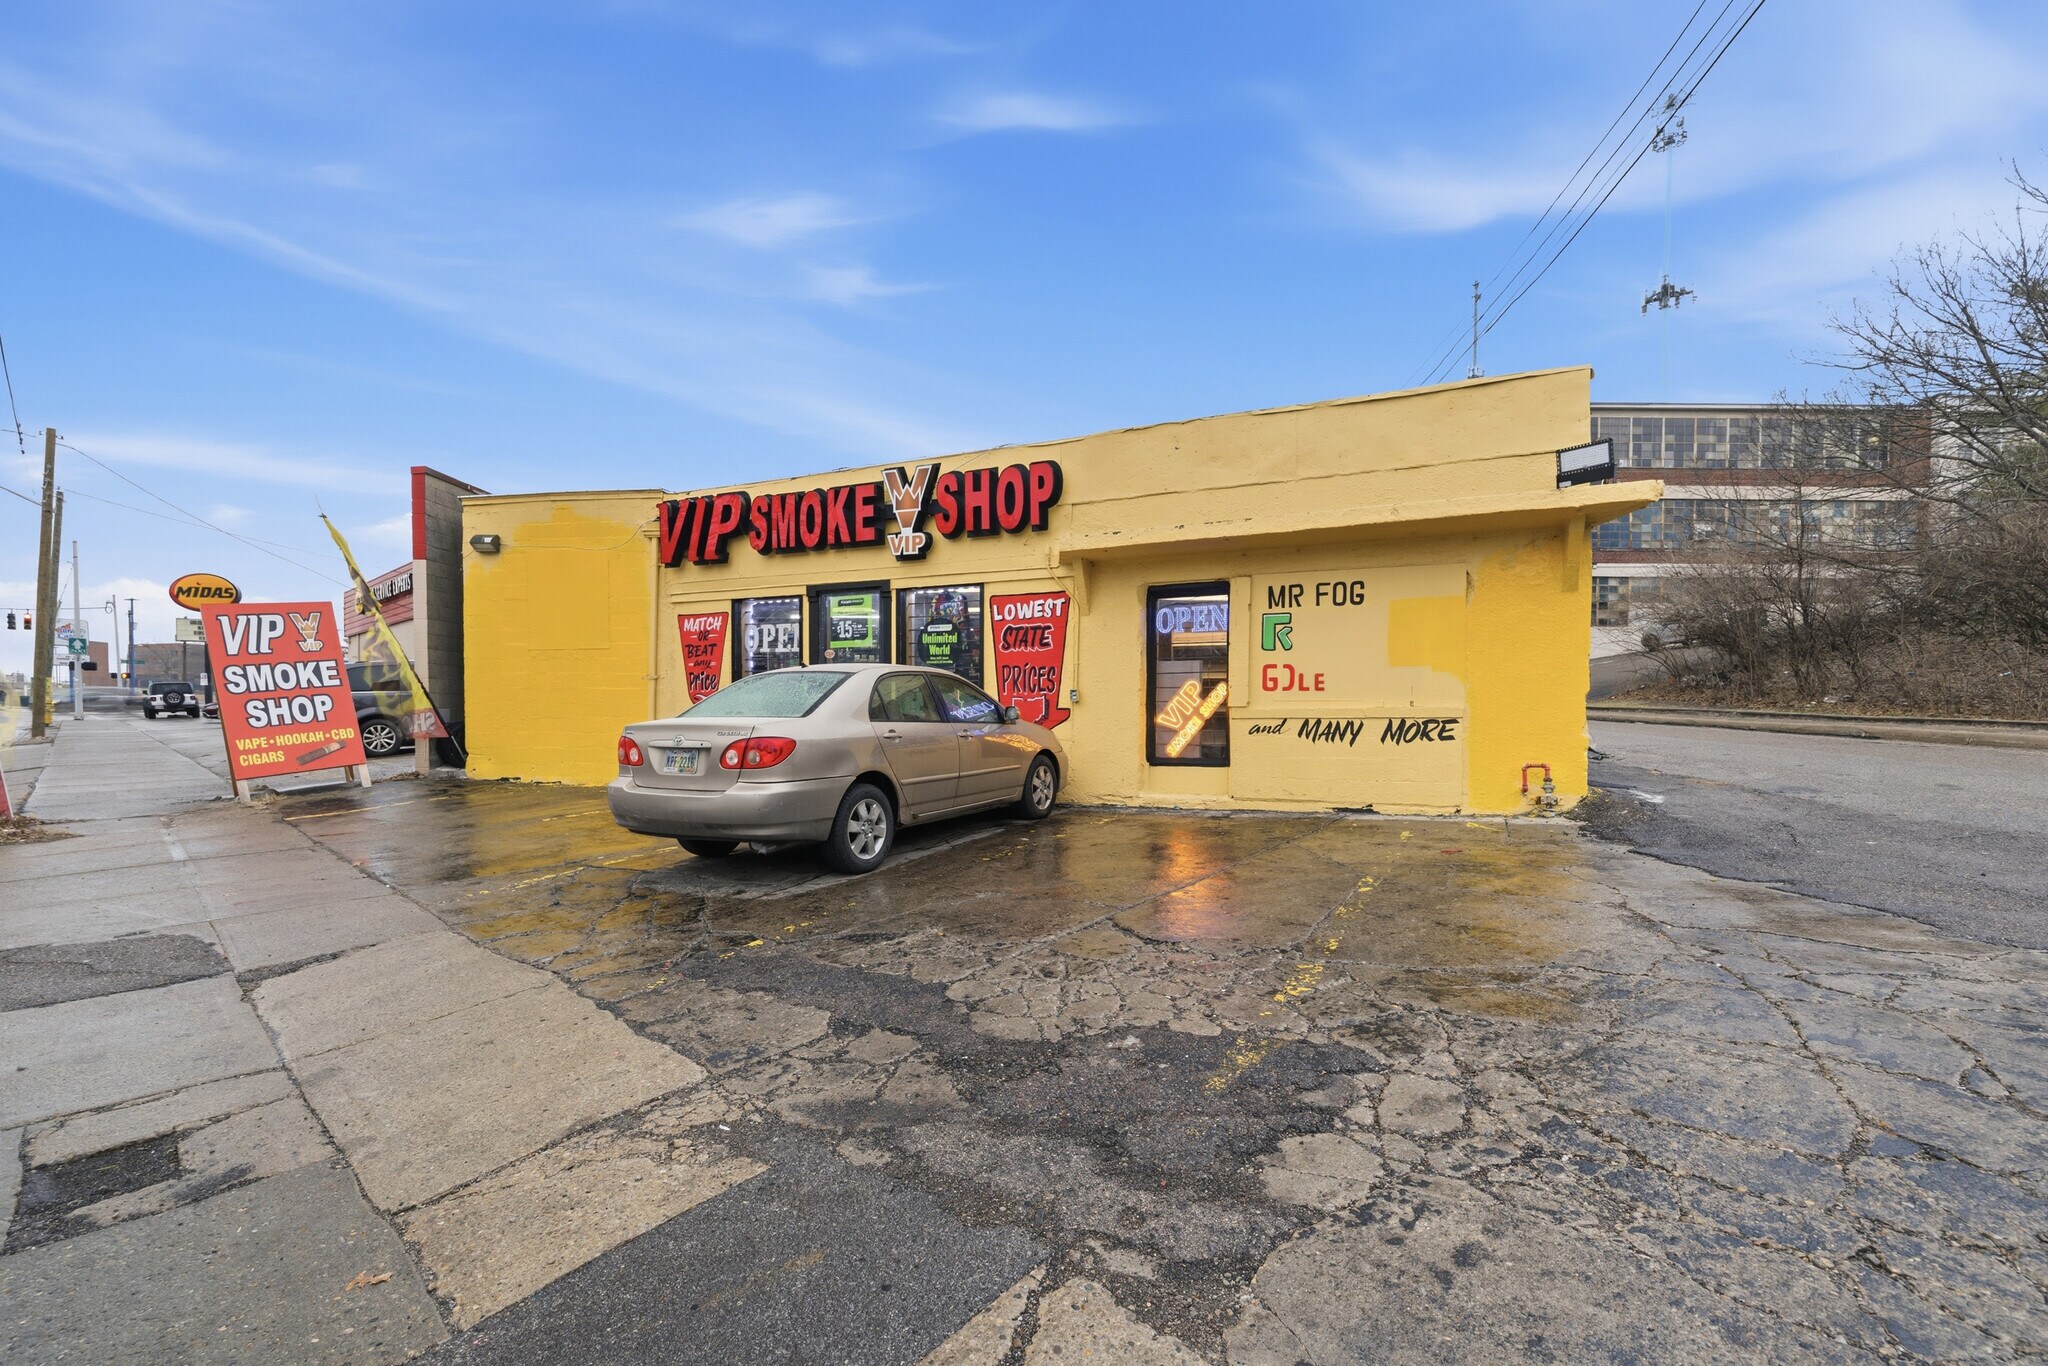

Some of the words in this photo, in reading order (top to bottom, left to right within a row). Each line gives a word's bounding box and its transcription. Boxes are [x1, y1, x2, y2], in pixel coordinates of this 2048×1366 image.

[656, 492, 748, 566] VIP
[749, 483, 881, 552] SMOKE
[935, 461, 1059, 537] SHOP
[887, 532, 928, 558] VIP
[176, 585, 234, 599] MIDAS
[1267, 583, 1304, 609] MR
[1315, 580, 1365, 607] FOG
[993, 598, 1066, 621] LOWEST
[1156, 604, 1229, 634] OPEN
[217, 613, 285, 656] VIP
[683, 616, 722, 632] MATCH
[697, 630, 710, 641] OR
[297, 641, 324, 652] VIP
[922, 632, 958, 644] Unlimited
[929, 644, 951, 655] World
[1001, 624, 1053, 652] STATE
[685, 643, 717, 658] BEAT
[224, 660, 342, 694] SMOKE
[245, 694, 333, 728] SHOP
[1158, 680, 1201, 729] VIP
[236, 737, 268, 750] VAPE
[275, 731, 325, 746] HOOKAH
[331, 727, 355, 741] CBD
[1248, 718, 1291, 736] and
[1297, 718, 1364, 747] MANY
[1380, 718, 1460, 746] MORE
[239, 750, 285, 766] CIGARS
